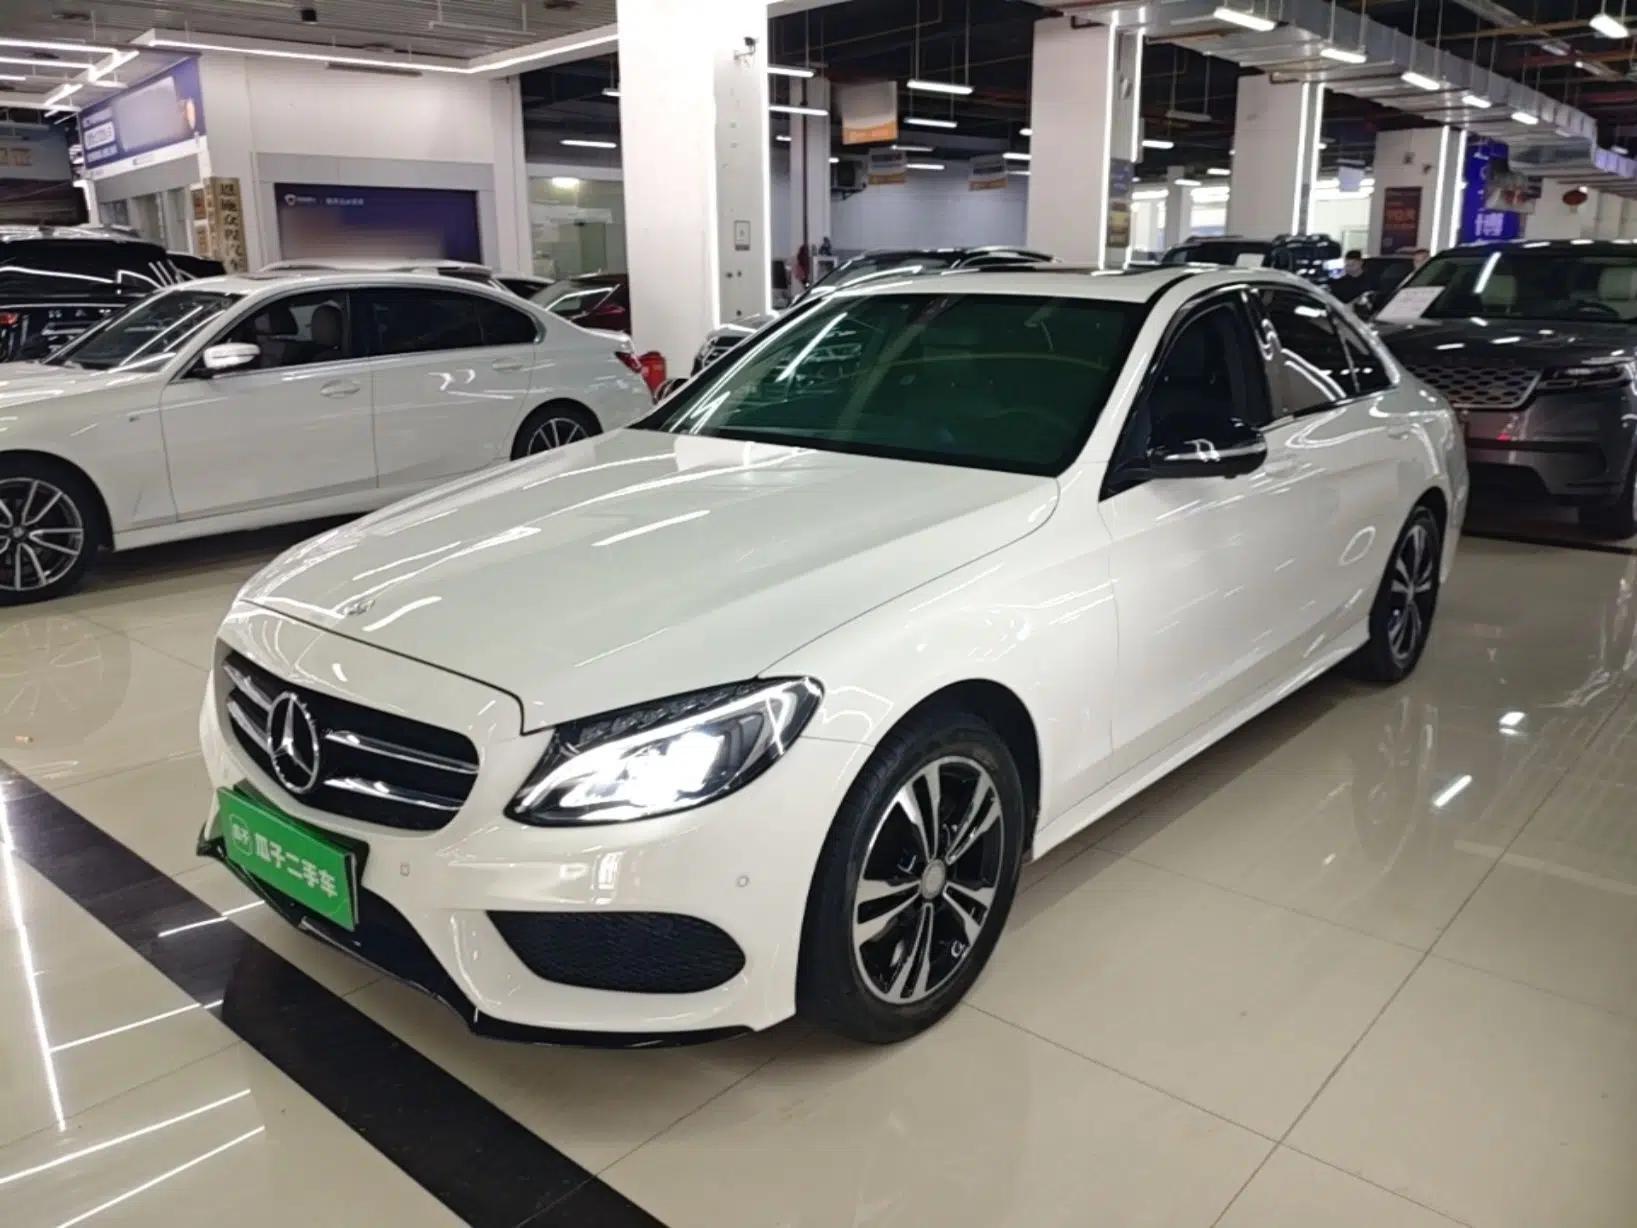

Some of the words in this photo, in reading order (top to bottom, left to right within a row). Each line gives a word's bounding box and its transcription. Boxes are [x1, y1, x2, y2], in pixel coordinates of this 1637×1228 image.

[255, 832, 338, 897] 瓜子二手车
